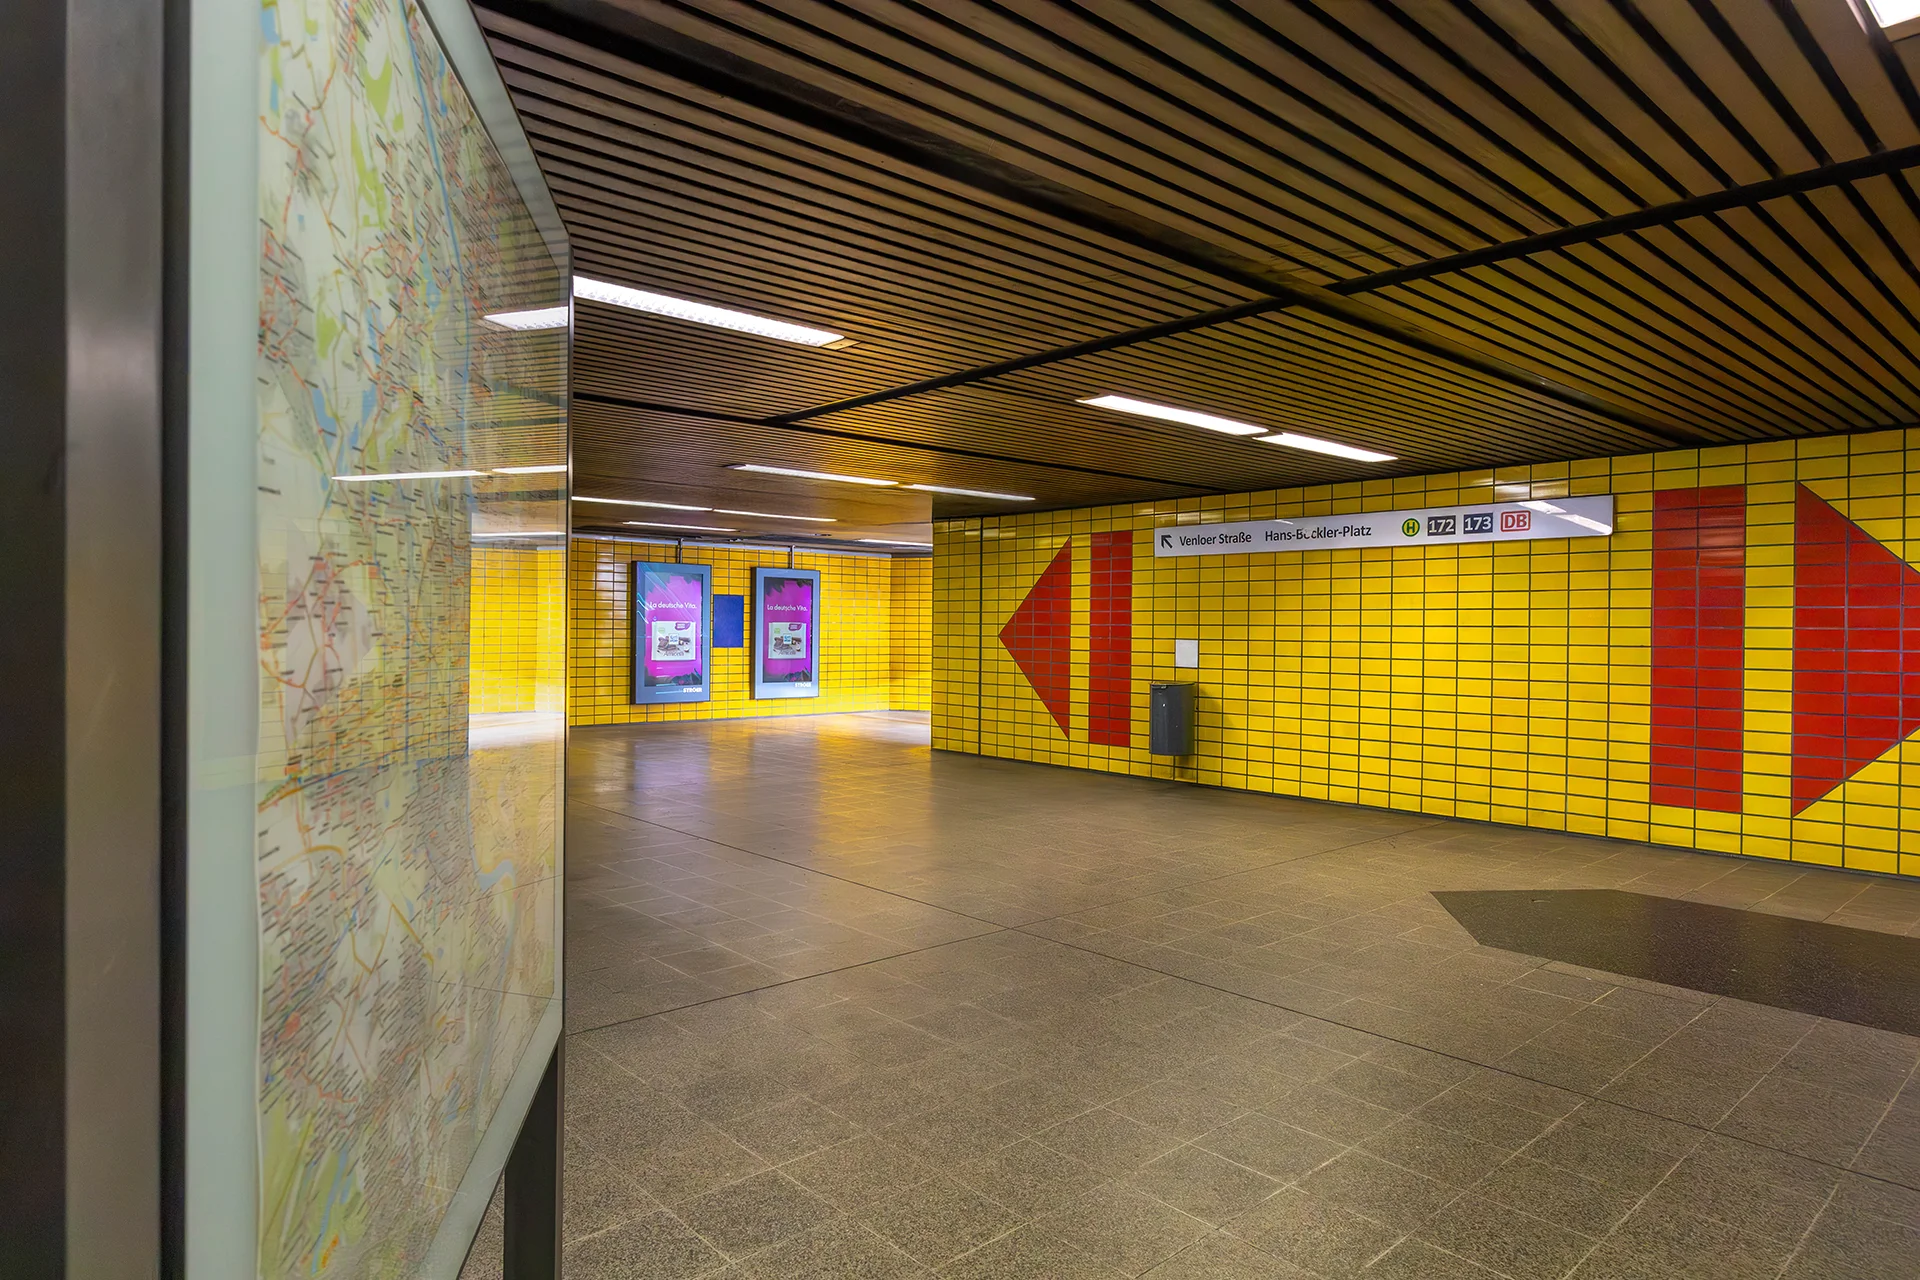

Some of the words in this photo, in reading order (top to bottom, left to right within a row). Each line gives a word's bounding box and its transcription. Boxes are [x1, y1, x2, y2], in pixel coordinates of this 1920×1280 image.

[1179, 534, 1216, 547] Venloer
[1218, 532, 1252, 545] Straße
[1428, 519, 1455, 533] 172
[1464, 516, 1492, 531] 173
[1504, 513, 1527, 529] DB
[658, 601, 684, 609] deutsche
